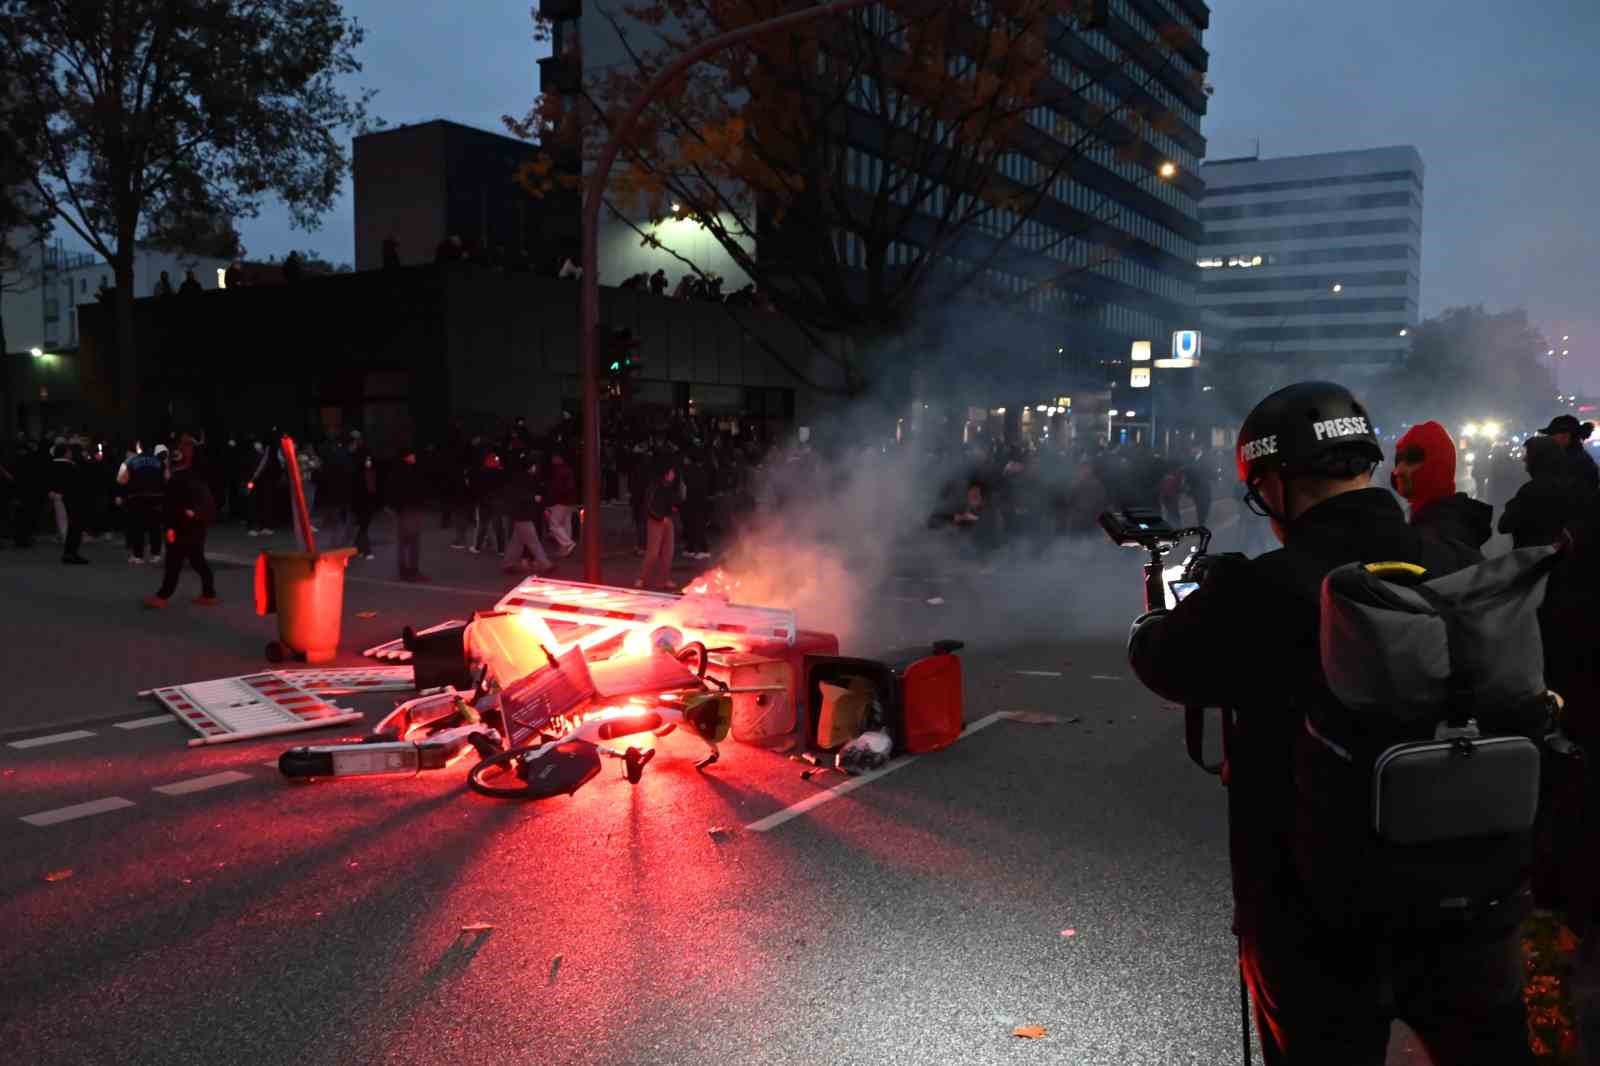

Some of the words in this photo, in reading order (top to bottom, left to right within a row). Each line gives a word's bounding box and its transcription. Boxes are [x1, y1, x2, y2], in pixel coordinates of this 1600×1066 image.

[1176, 330, 1197, 358] U
[1313, 416, 1369, 441] PRESSE
[1240, 435, 1279, 463] PRESSE
